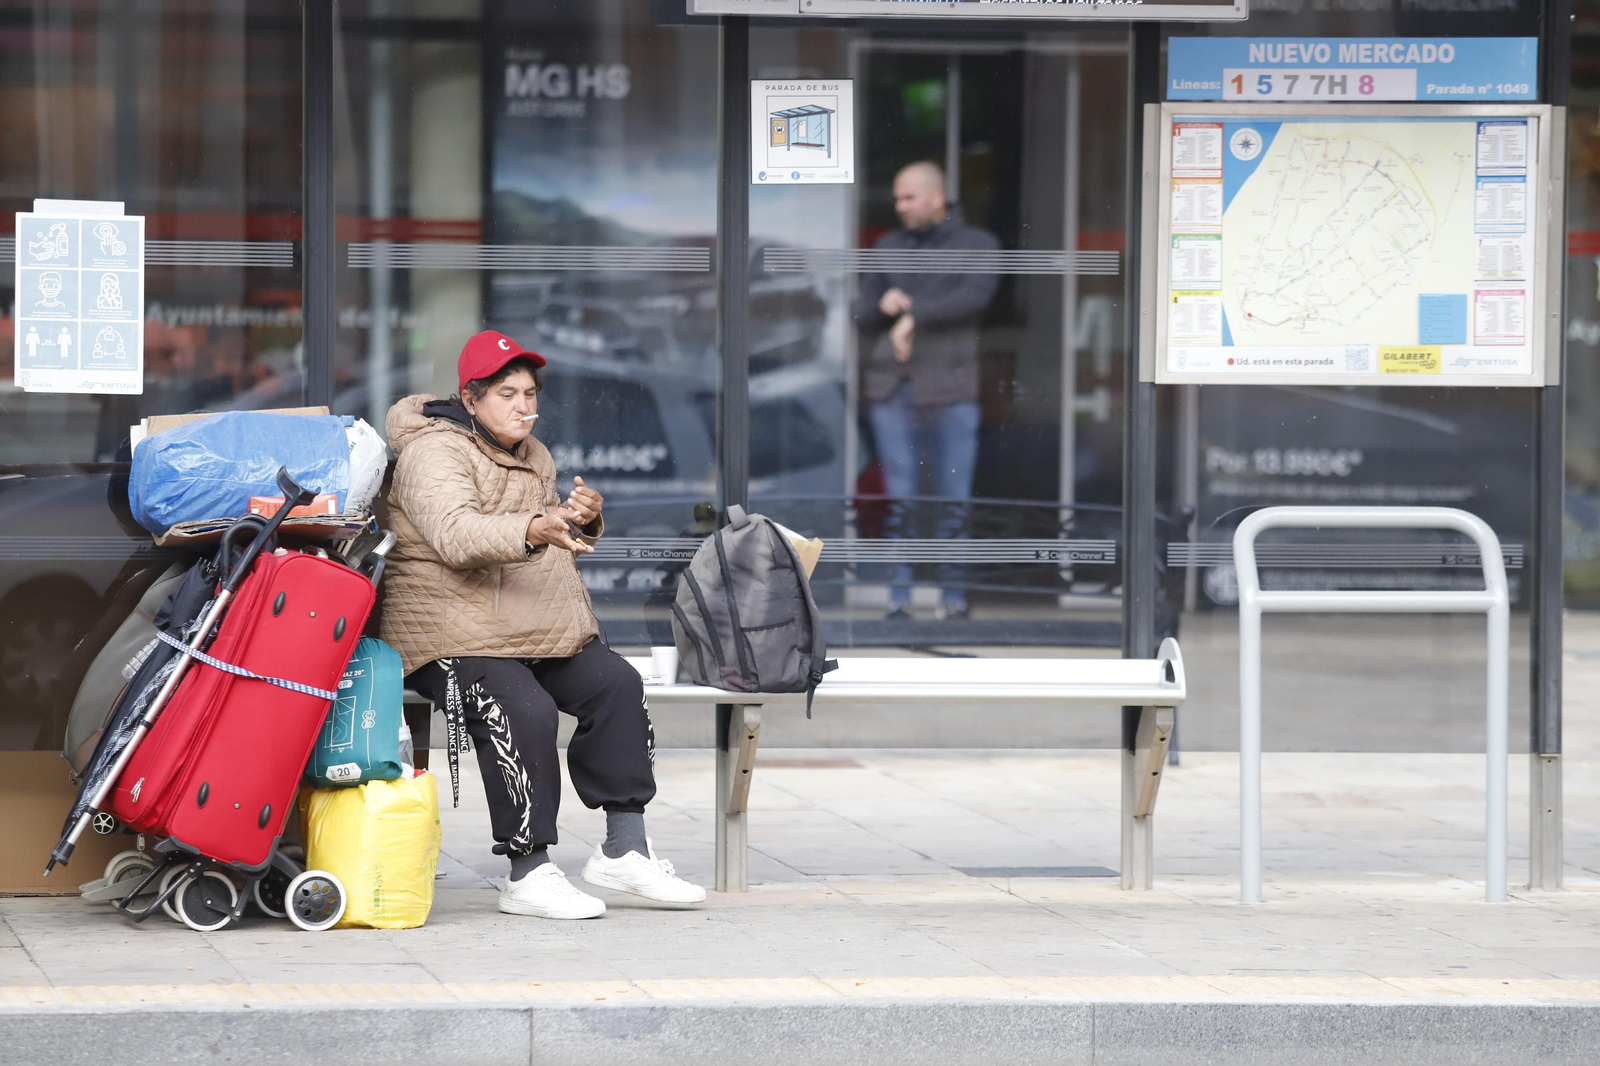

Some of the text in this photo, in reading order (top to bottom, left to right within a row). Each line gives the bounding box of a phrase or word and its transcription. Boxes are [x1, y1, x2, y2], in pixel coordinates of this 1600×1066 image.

[1249, 43, 1456, 64] NUEVO MERCADO
[504, 63, 630, 100] MG HS
[1172, 74, 1375, 95] Líneas: 1 5 7 7H 8
[1426, 83, 1475, 95] Parada
[1496, 83, 1529, 95] 1049
[498, 338, 510, 351] C
[1236, 358, 1251, 366] Ud.
[1253, 358, 1270, 366] está
[1285, 358, 1302, 366] esta
[1304, 358, 1334, 367] parada
[1383, 353, 1432, 361] GILABERT
[1477, 358, 1519, 366] EMTUSA
[641, 549, 695, 558] Clear Channel
[1049, 551, 1102, 560] Clear Channel
[446, 678, 455, 711] IMPRESS
[448, 722, 457, 753] DANCE
[337, 767, 350, 777] 20
